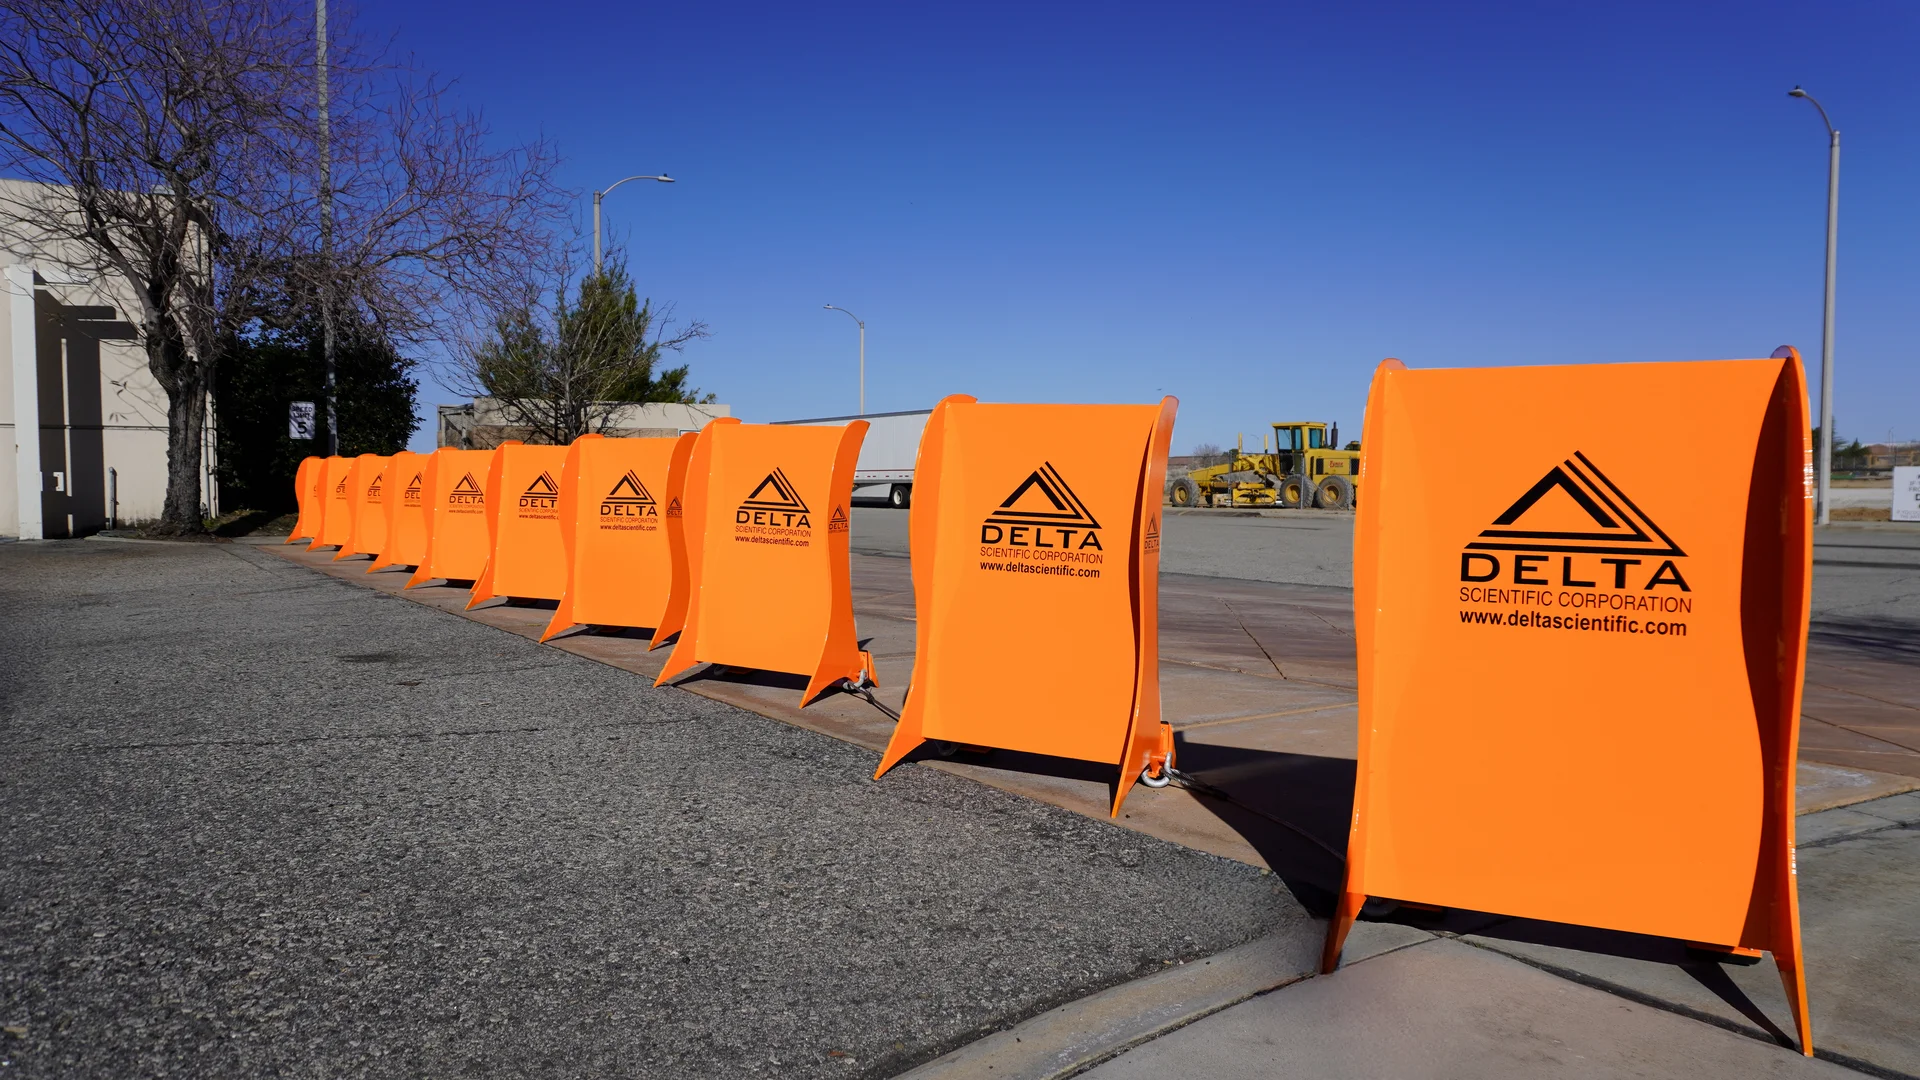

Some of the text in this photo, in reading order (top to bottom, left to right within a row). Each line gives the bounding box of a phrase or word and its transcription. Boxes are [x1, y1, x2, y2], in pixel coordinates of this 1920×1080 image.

[297, 421, 308, 434] 5
[404, 491, 421, 499] DEL
[449, 495, 485, 504] DELTA
[519, 498, 558, 508] DELT
[600, 504, 658, 517] DELTA
[736, 510, 812, 529] DELTA
[828, 522, 849, 530] DELTA
[735, 525, 812, 537] SCIENTIFIC CORPORATION
[980, 524, 1104, 551] DELTA
[734, 535, 809, 547] www.deltascientific.com
[979, 546, 1104, 564] SCIENTIFIC CORPORATION
[979, 561, 1100, 578] www.deltascientific.com
[1460, 552, 1692, 593] DELTA
[1459, 586, 1692, 614] SCIENTIFIC CORPORATION
[1459, 609, 1687, 637] www.deltascientific.com
